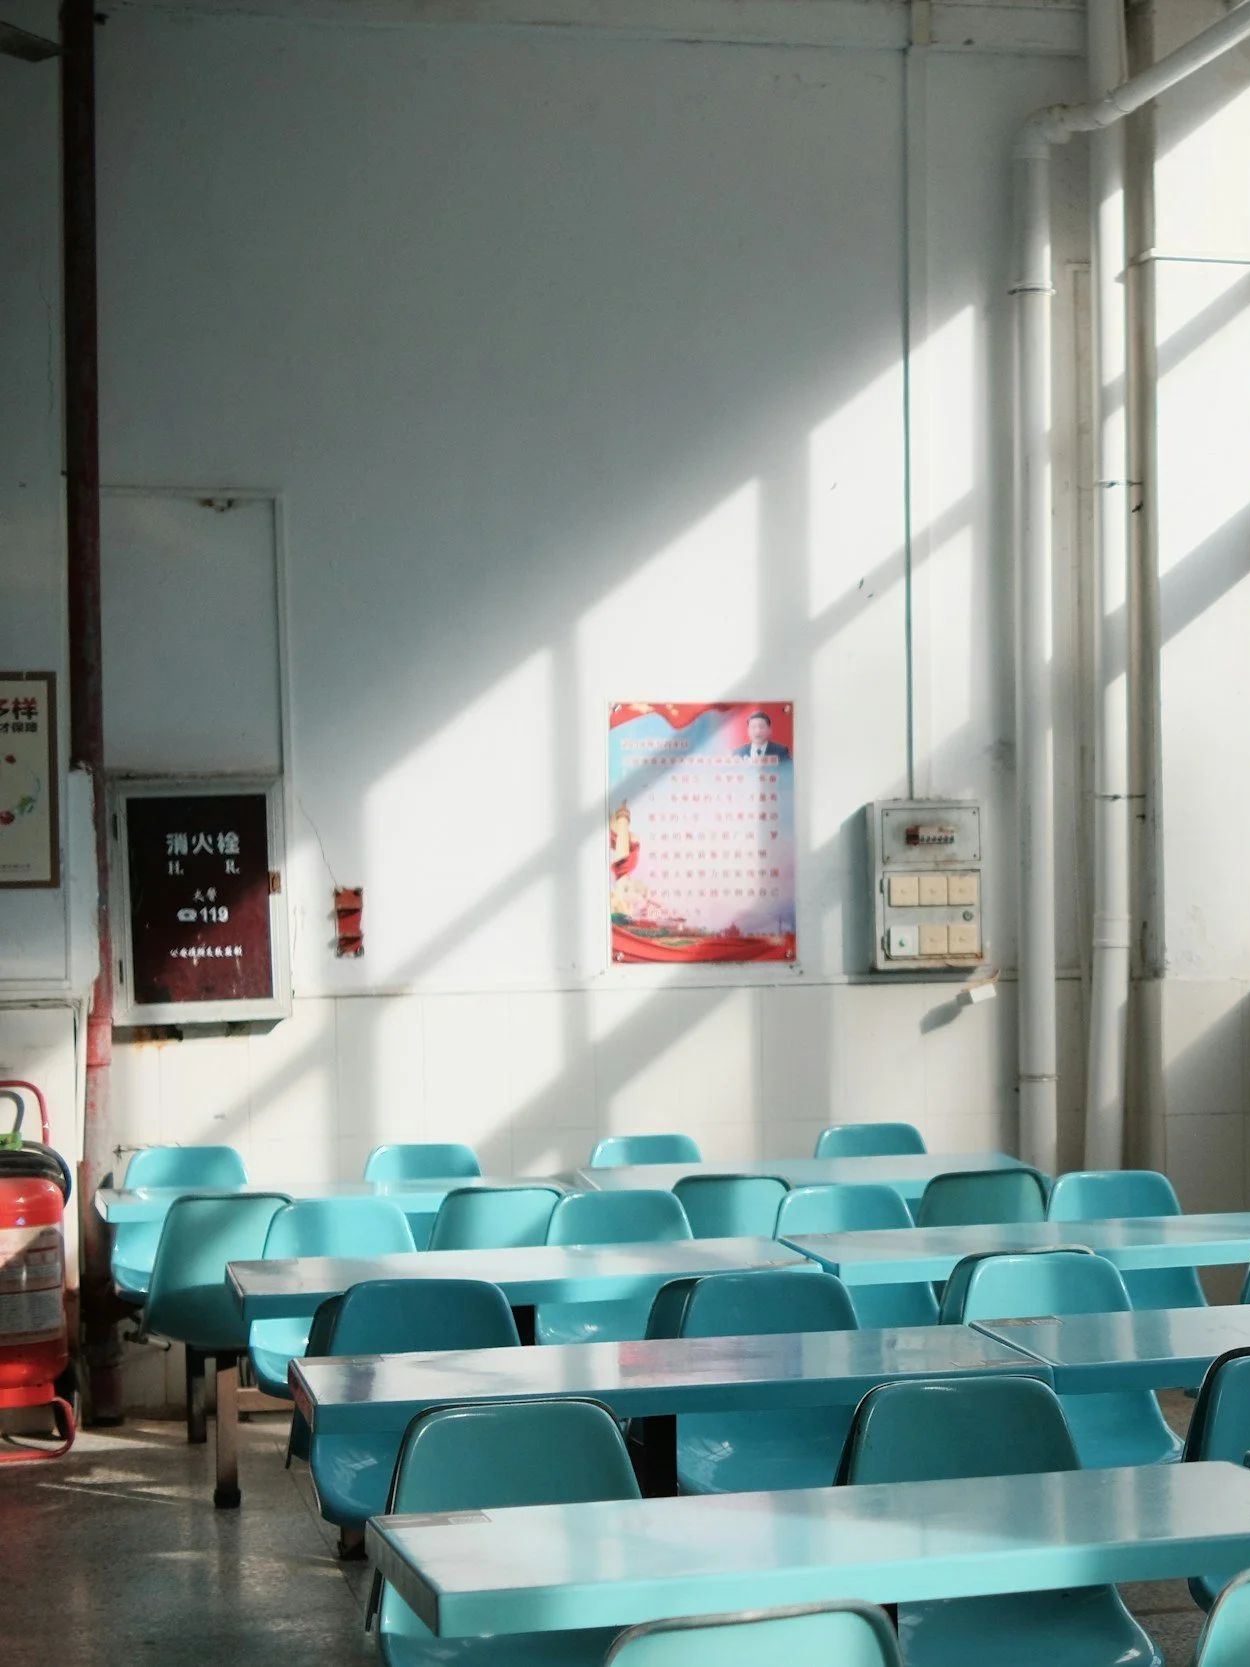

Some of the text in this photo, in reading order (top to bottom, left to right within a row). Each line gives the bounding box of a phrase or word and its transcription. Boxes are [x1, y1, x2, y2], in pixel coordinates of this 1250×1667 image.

[166, 832, 240, 856] 消火栓
[200, 905, 229, 923] 119
